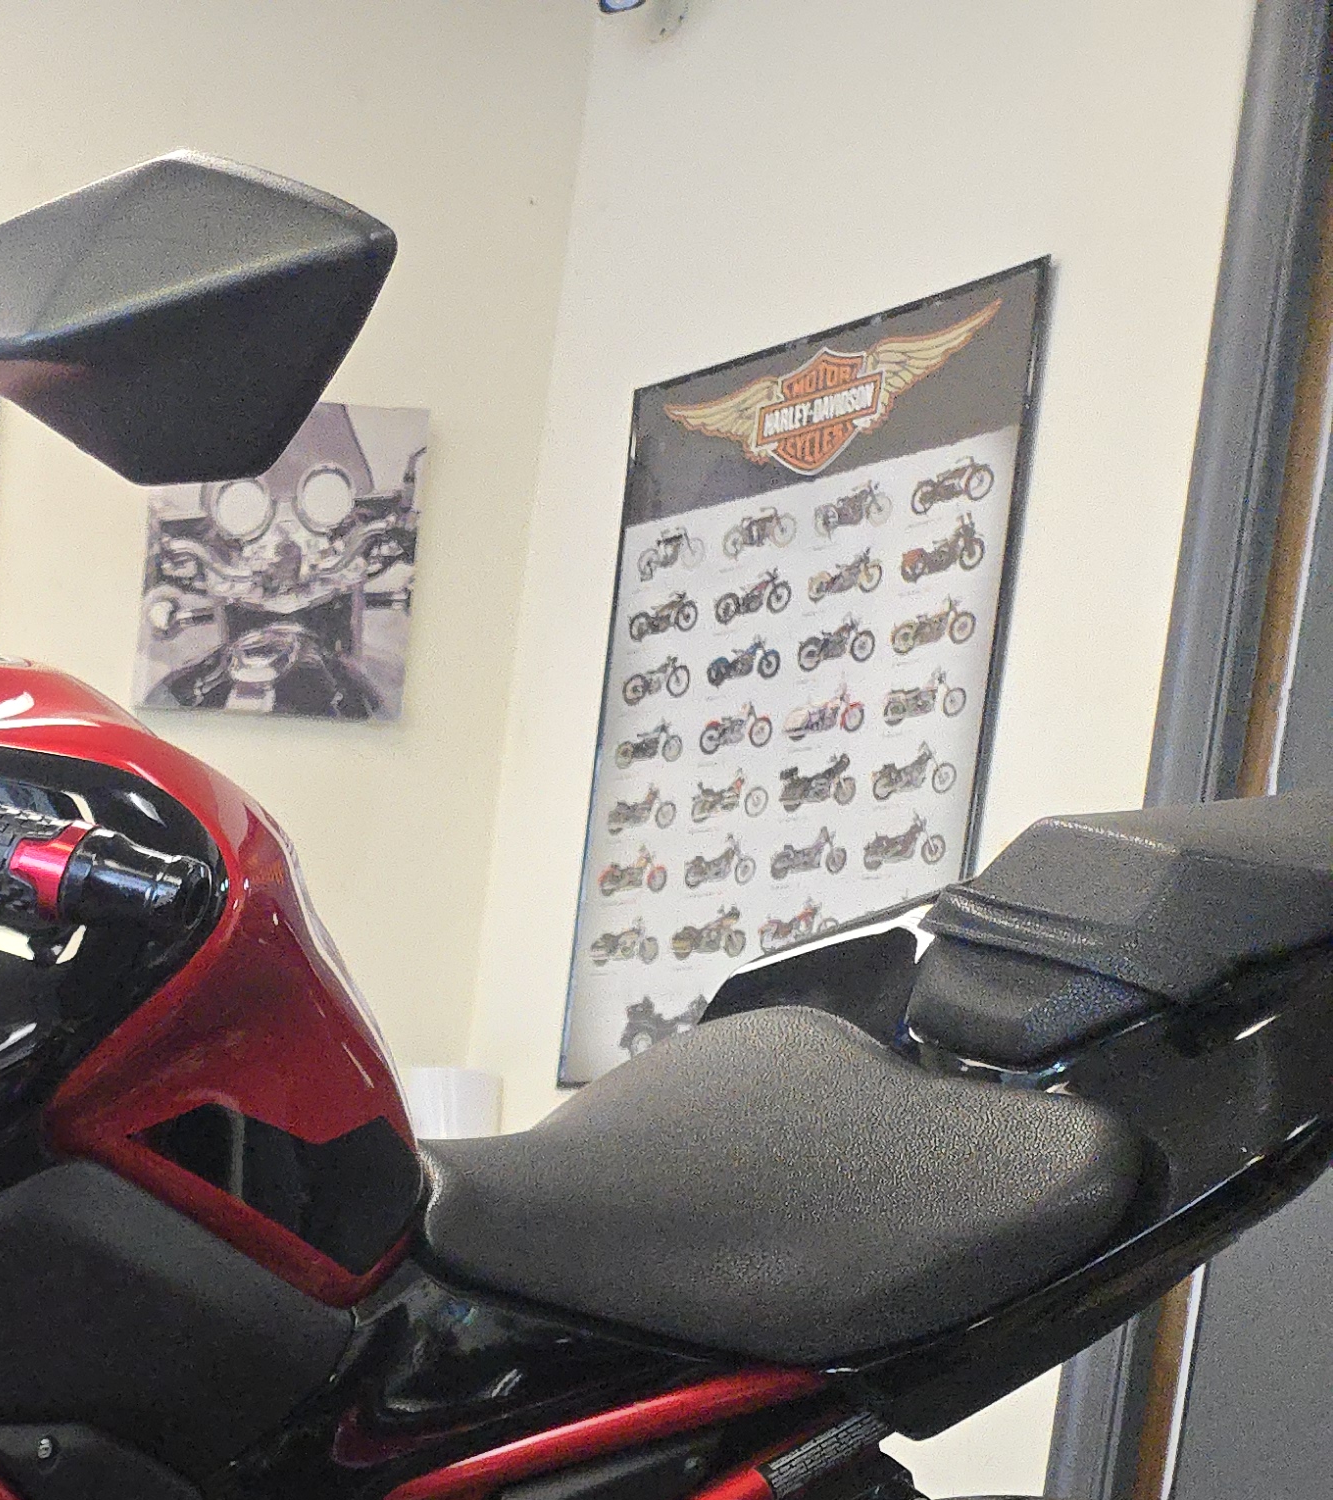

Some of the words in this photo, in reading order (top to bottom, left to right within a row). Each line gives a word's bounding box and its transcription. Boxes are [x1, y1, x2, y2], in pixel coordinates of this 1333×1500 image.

[792, 362, 852, 396] MOTOR
[762, 381, 875, 438] HARLEY-DAVIDSON
[786, 424, 844, 462] CYCLES
